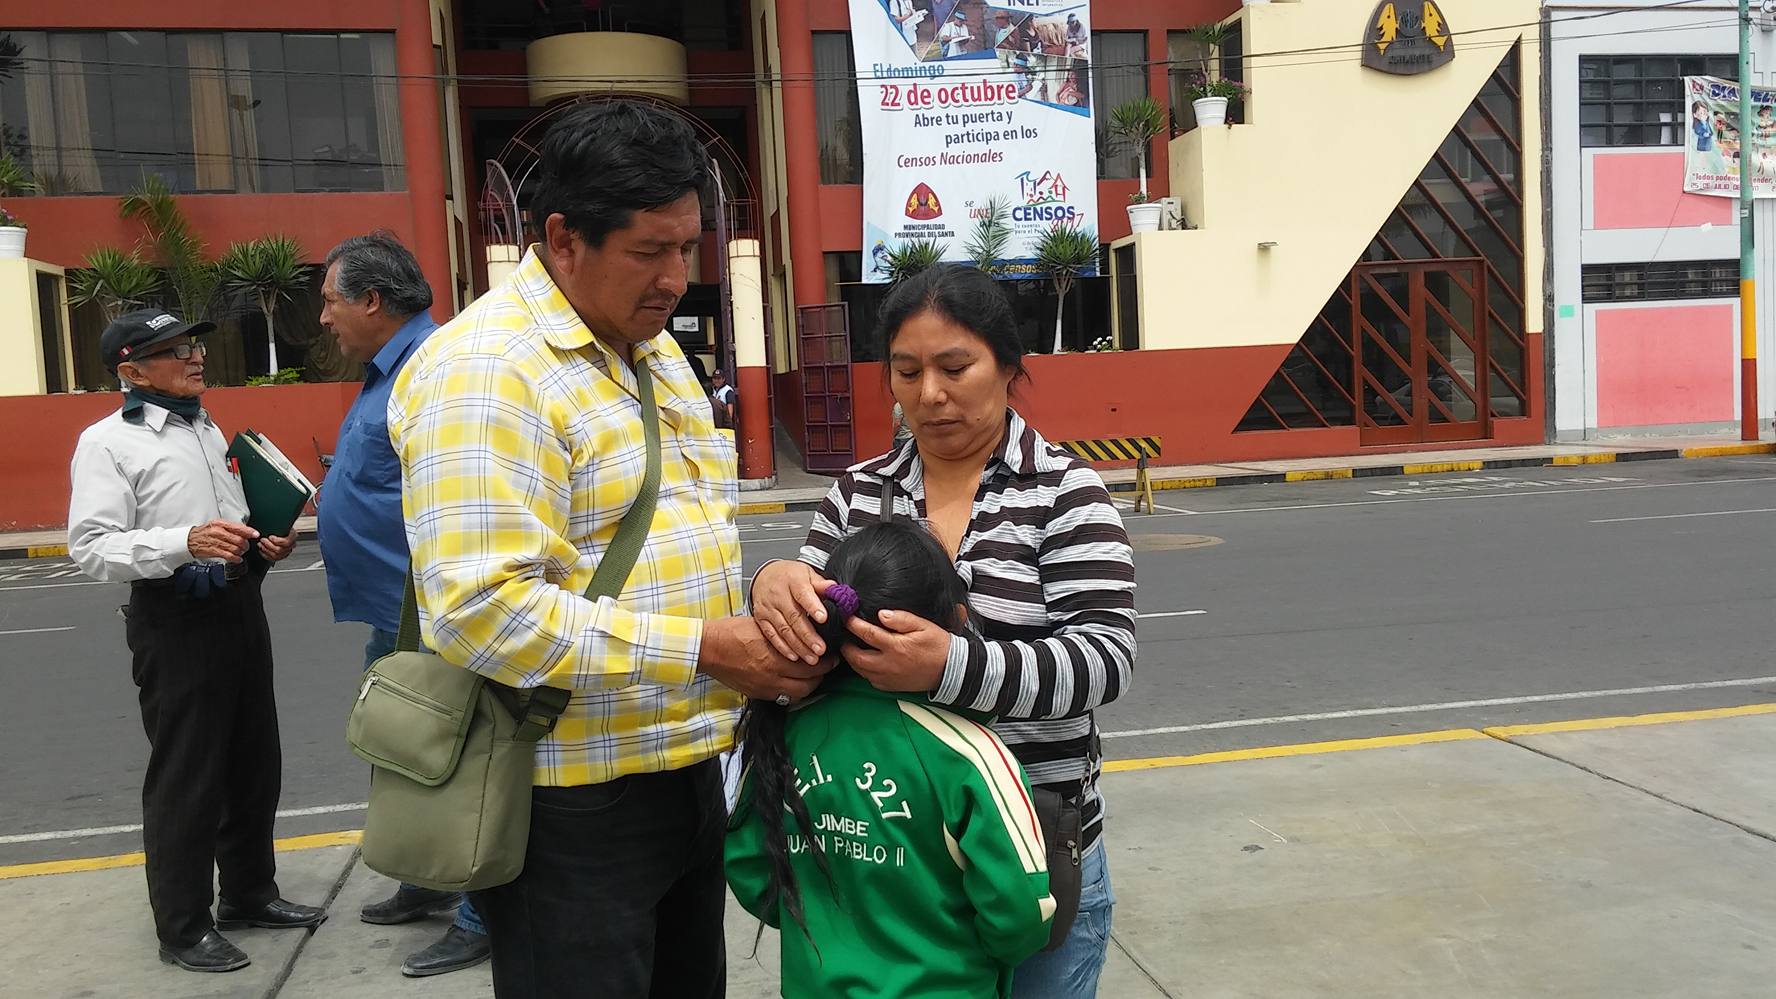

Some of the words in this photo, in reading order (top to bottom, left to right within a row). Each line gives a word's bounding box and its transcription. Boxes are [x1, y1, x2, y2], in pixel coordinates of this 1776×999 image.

[873, 63, 883, 78] El
[886, 62, 945, 80] domingo
[880, 84, 901, 107] 22
[907, 82, 932, 106] de
[937, 79, 1017, 104] octubre
[914, 113, 943, 128] Abre
[945, 112, 959, 125] tu
[962, 109, 1003, 128] puerta
[1006, 110, 1014, 125] y
[945, 128, 1000, 148] participa
[1003, 129, 1018, 140] en
[1021, 125, 1038, 139] los
[897, 154, 937, 168] Censos
[940, 148, 1004, 166] Nacionales
[1012, 205, 1075, 221] CENSOS
[894, 231, 926, 239] PROVINCIAL
[937, 230, 955, 238] SANTA
[903, 223, 946, 231] MUNICIPALIDAD
[855, 761, 912, 820] 327
[813, 813, 870, 837] JIMBE
[834, 836, 887, 864] PABLO
[896, 847, 904, 867] II
